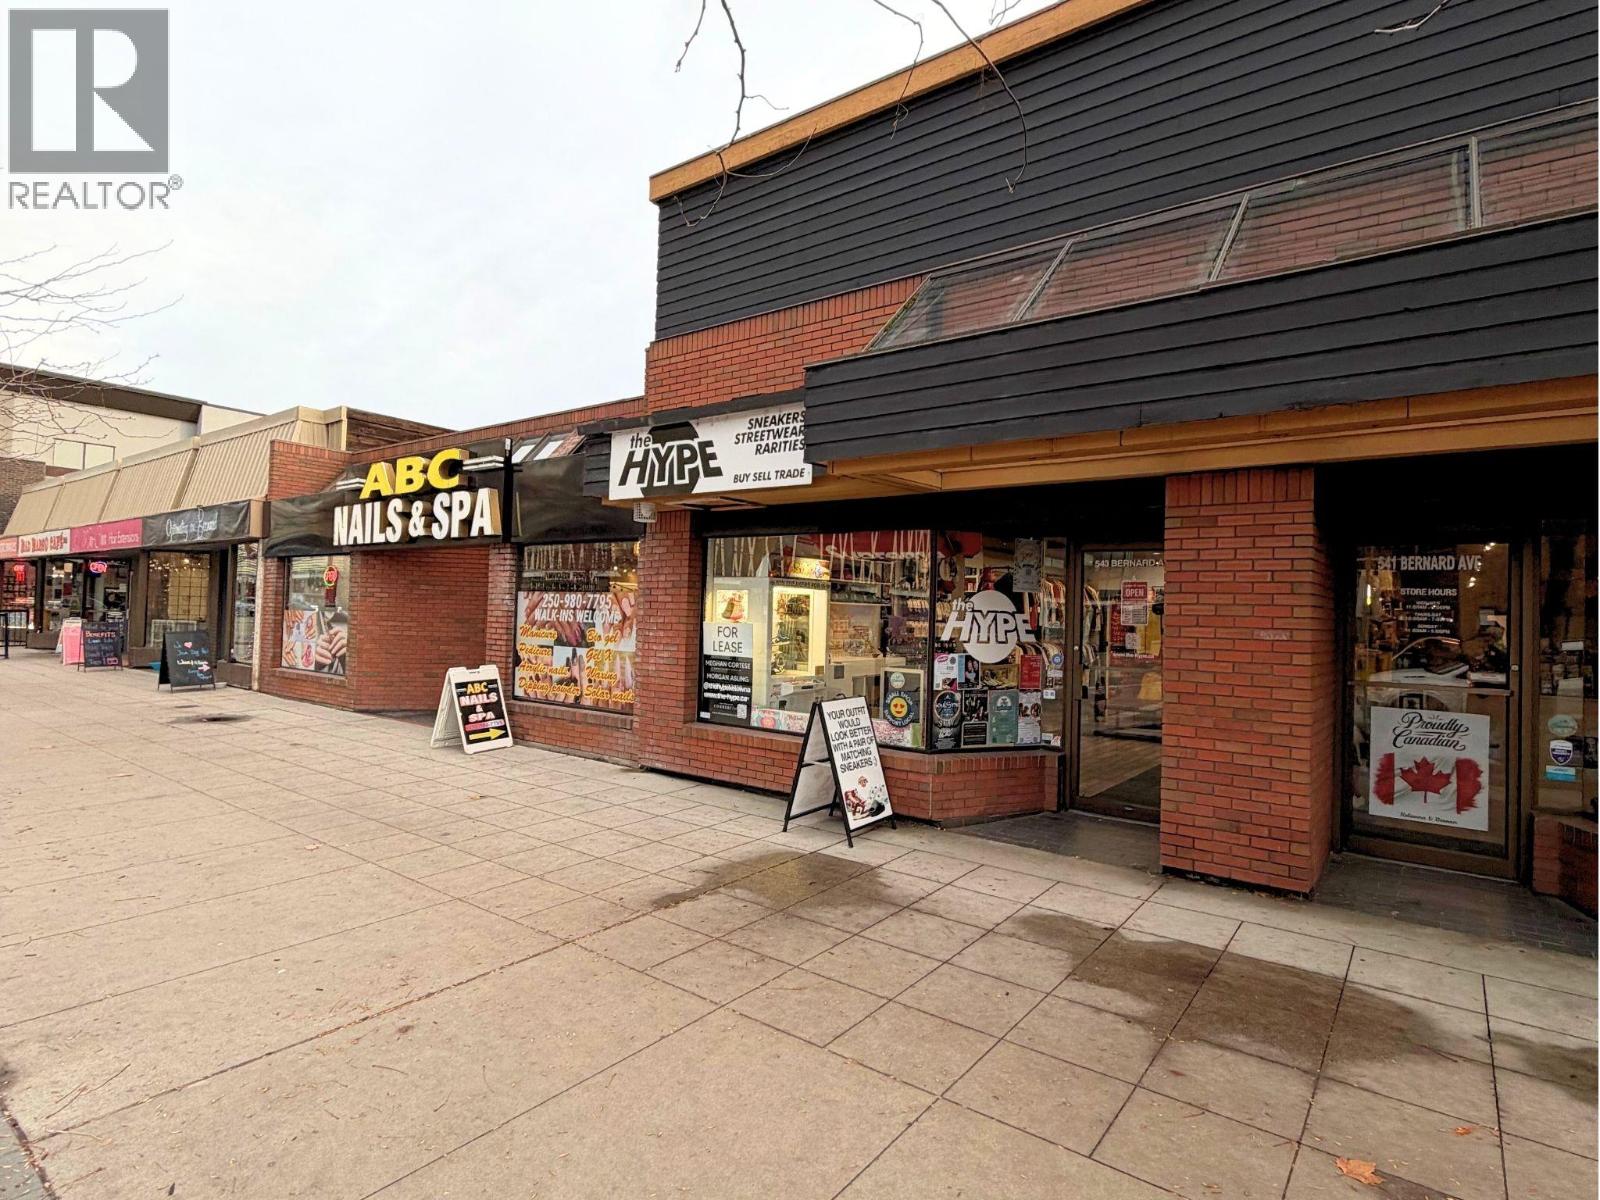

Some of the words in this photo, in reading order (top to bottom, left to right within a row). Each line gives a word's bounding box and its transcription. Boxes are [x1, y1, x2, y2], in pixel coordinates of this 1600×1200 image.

[748, 410, 806, 430] SNEAKERS
[630, 433, 652, 448] the
[734, 425, 805, 445] STREETWEAR
[755, 438, 806, 456] RARITIES
[618, 440, 723, 487] HYPE
[359, 448, 465, 500] ABC
[733, 472, 750, 484] BUY
[753, 470, 771, 482] SELL
[774, 467, 805, 480] TRADE
[333, 498, 403, 546] NAILS
[408, 501, 426, 538] &
[431, 488, 497, 540] SPA
[1095, 559, 1109, 568] 543
[1111, 559, 1156, 568] BERNARD
[1378, 555, 1397, 570] 541
[1400, 555, 1455, 570] BERNARD
[1457, 555, 1482, 570] AVE
[1125, 588, 1144, 597] OPEN
[1400, 588, 1428, 596] STORE
[1428, 588, 1457, 596] HOURS
[541, 593, 612, 609] 250-980-7795
[952, 597, 974, 611] the
[534, 608, 574, 622] WALK-INS
[576, 608, 622, 623] WELCOME
[519, 624, 557, 640] Manicure
[717, 626, 738, 638] FOR
[940, 611, 1037, 644] HYPE
[587, 628, 602, 642] Bio
[603, 630, 619, 646] gel
[519, 642, 552, 656] Pedicure
[586, 648, 600, 661] Gel
[604, 648, 613, 660] X
[712, 641, 743, 654] LEASE
[705, 660, 727, 668] MEGHAN
[586, 666, 618, 685] Waxing
[467, 682, 488, 694] ABC
[518, 676, 550, 693] Dipping
[550, 682, 581, 696] powder
[459, 692, 498, 707] NAILS
[585, 685, 610, 700] Solar
[612, 689, 635, 703] nails
[476, 704, 483, 713] &
[827, 710, 845, 720] YOUR
[846, 706, 866, 717] OUTFIT
[468, 712, 495, 723] SPA
[838, 718, 861, 729] WOULD
[1401, 711, 1469, 738] Proudly
[831, 730, 849, 742] LOOK
[849, 726, 872, 738] BETTER
[1392, 726, 1466, 751] Canadian
[833, 742, 848, 752] WITH
[853, 738, 866, 748] PAIR
[867, 735, 875, 745] OF
[841, 747, 872, 762] MATCHING
[840, 757, 873, 773] SNEAKERS
